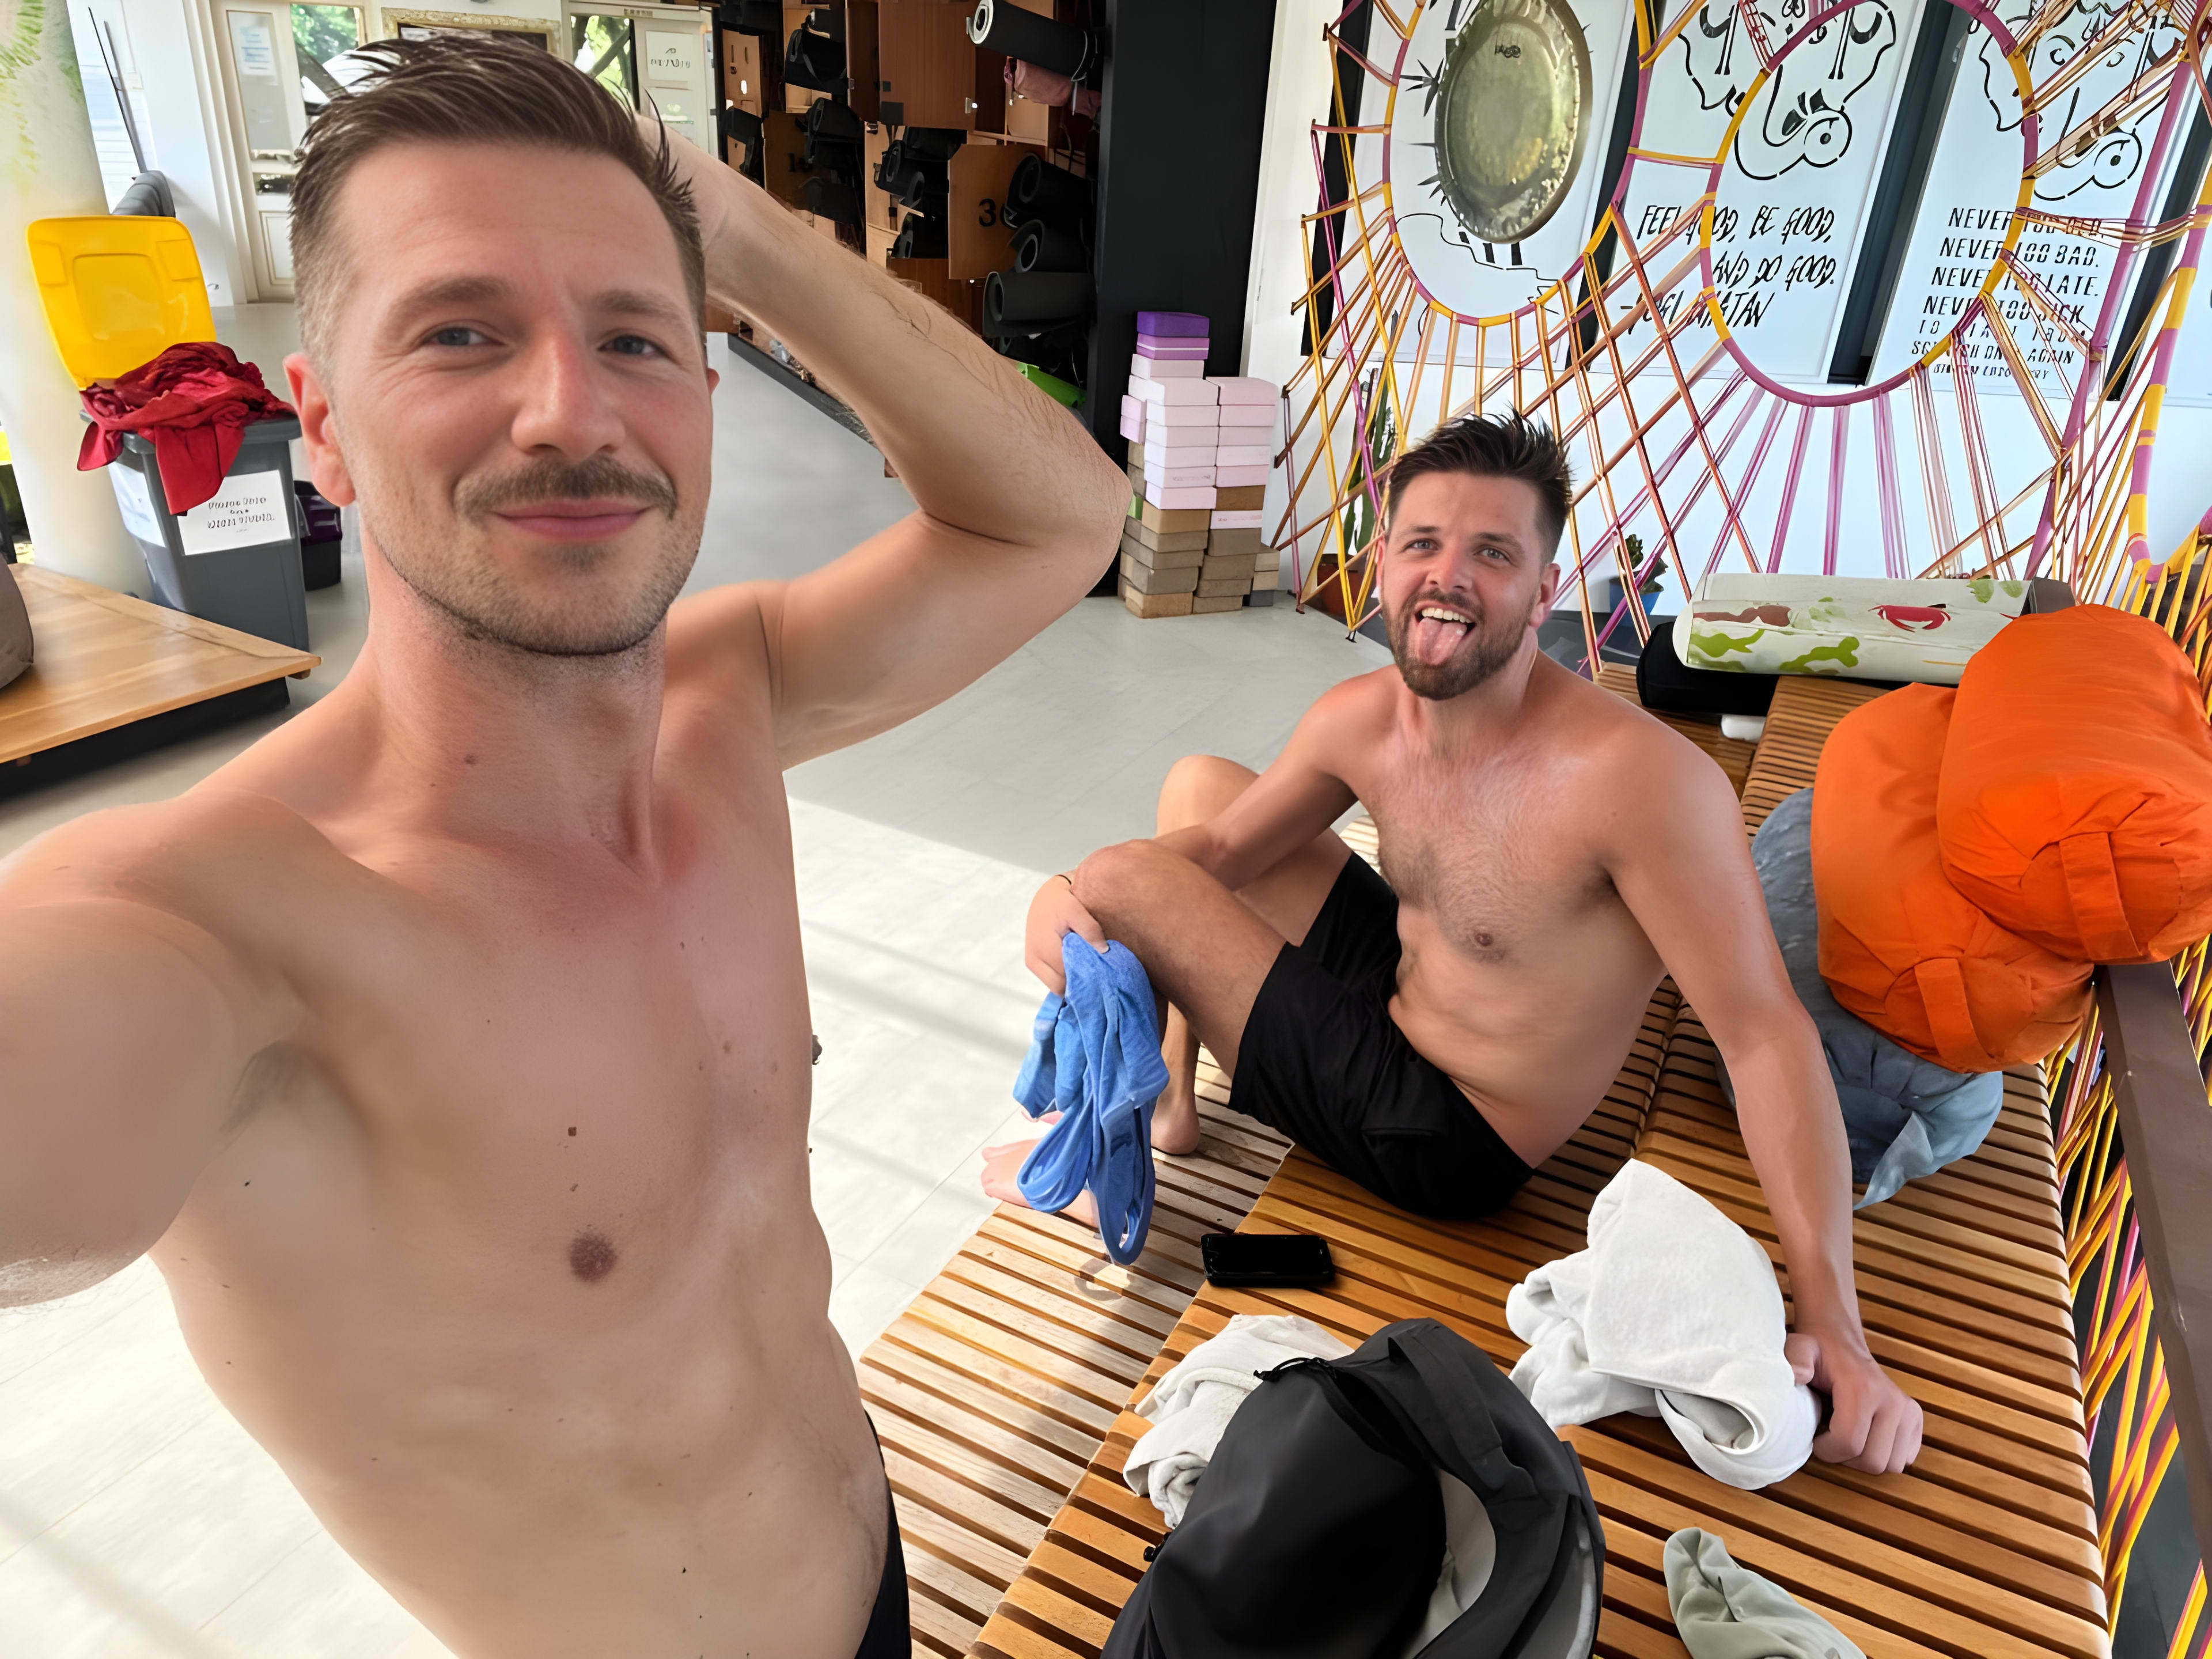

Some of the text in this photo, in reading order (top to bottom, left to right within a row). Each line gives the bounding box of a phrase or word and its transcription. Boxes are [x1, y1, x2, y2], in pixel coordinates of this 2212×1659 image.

[1685, 206, 1738, 245] GOD,
[1749, 205, 1780, 239] BE
[1781, 206, 1835, 245] GOOD,
[2054, 245, 2099, 268] BAD.
[1748, 255, 1782, 289] DO
[1785, 255, 1836, 291] GOOD.
[1931, 267, 1991, 288] NEVE
[1923, 296, 1977, 316] NEV
